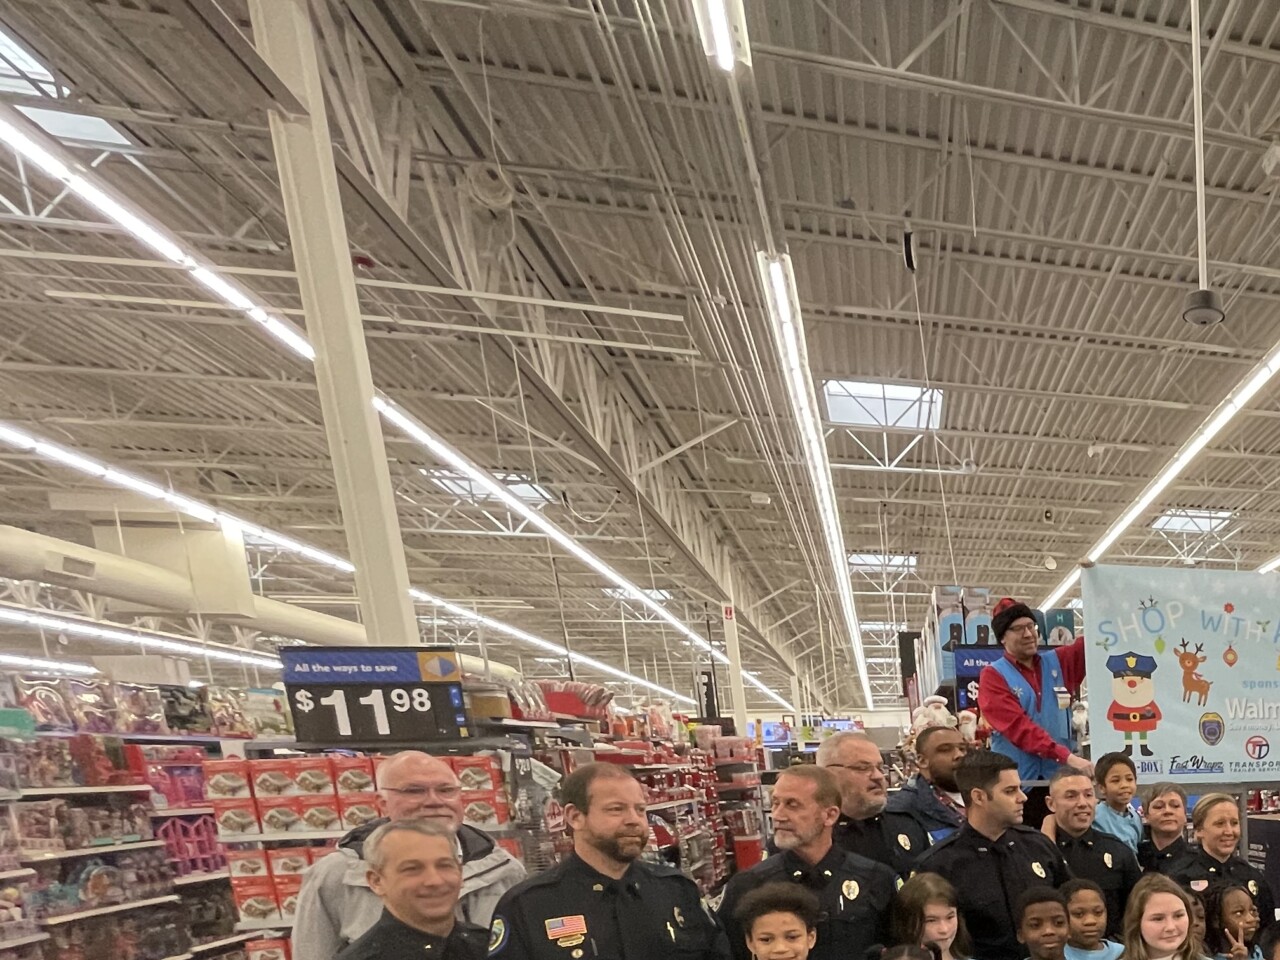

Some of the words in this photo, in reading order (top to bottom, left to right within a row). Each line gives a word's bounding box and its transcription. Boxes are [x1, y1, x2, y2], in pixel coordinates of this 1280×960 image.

[1098, 600, 1184, 647] SHOP
[1200, 609, 1262, 643] WITH
[963, 658, 975, 666] All
[294, 663, 310, 673] All
[311, 663, 331, 673] the
[332, 664, 358, 674] ways
[360, 664, 373, 673] to
[374, 664, 398, 673] save
